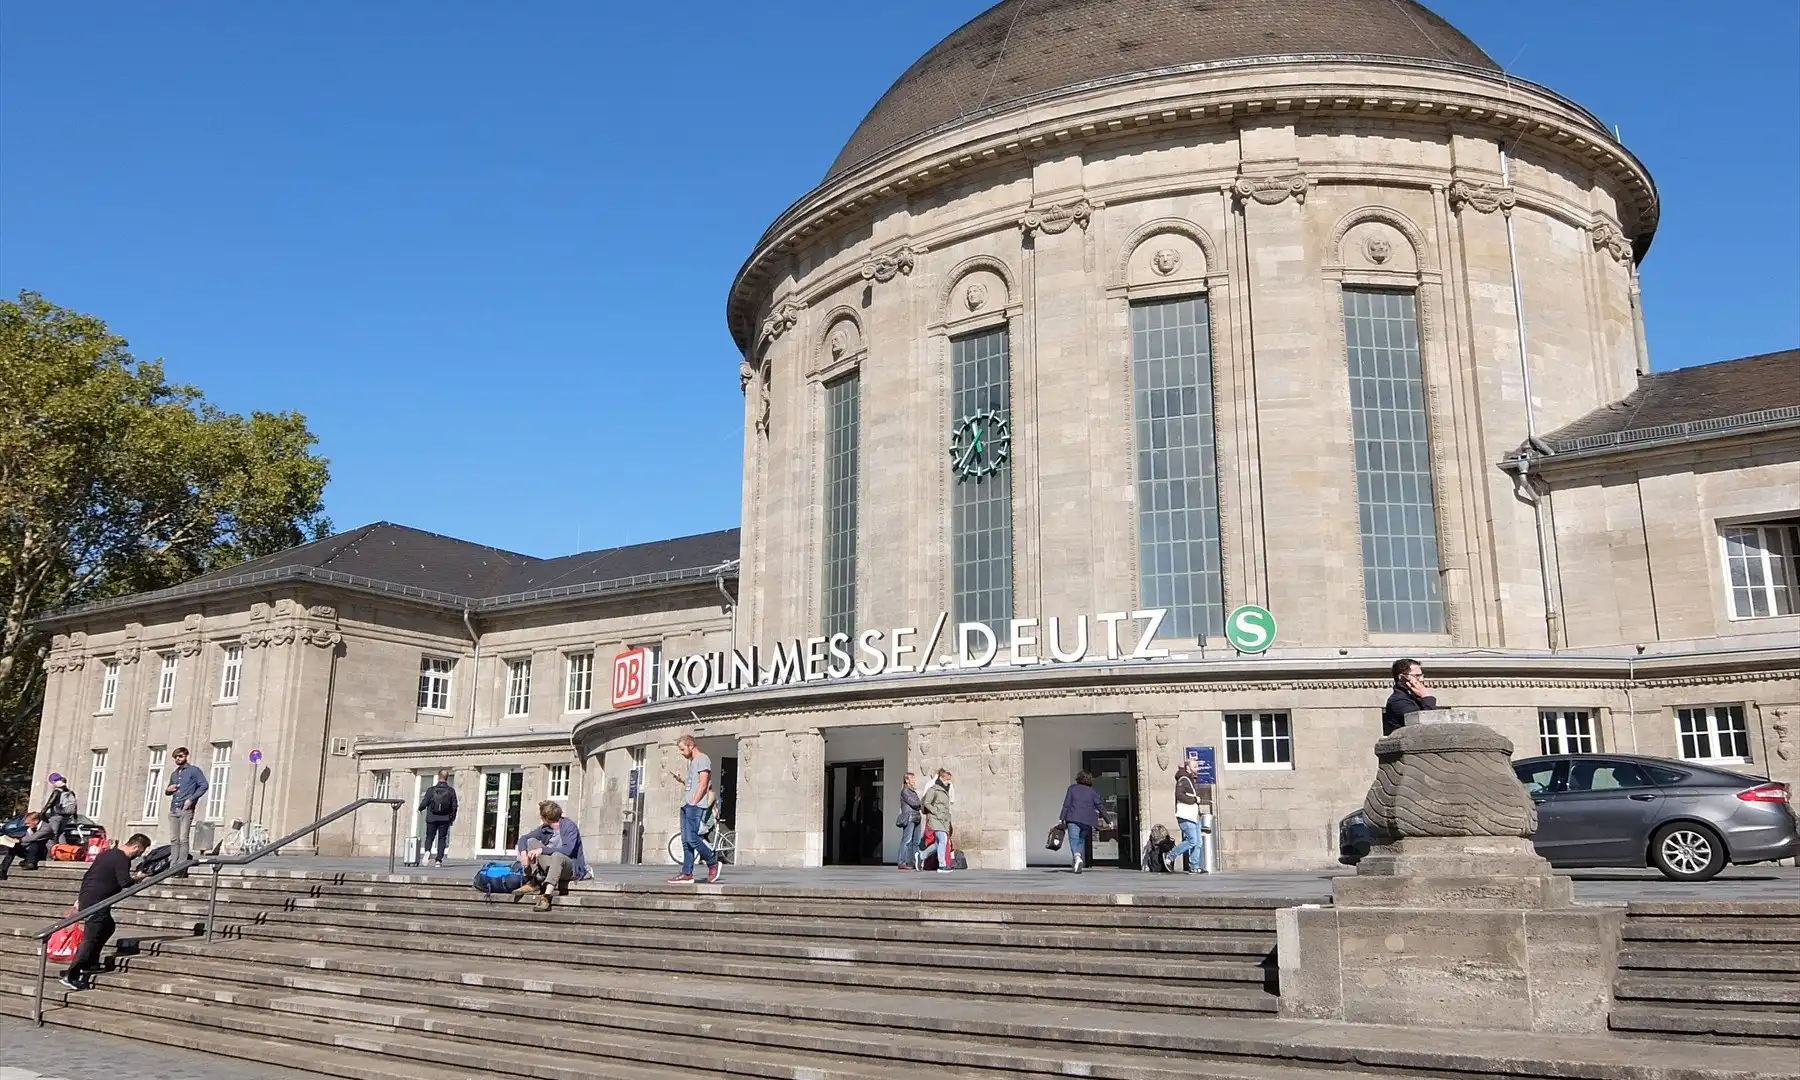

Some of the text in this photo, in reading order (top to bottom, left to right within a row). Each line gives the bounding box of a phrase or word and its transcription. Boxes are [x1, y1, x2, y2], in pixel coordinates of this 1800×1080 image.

[1235, 611, 1267, 647] S
[615, 658, 640, 699] DB
[664, 645, 759, 698] KÖLN
